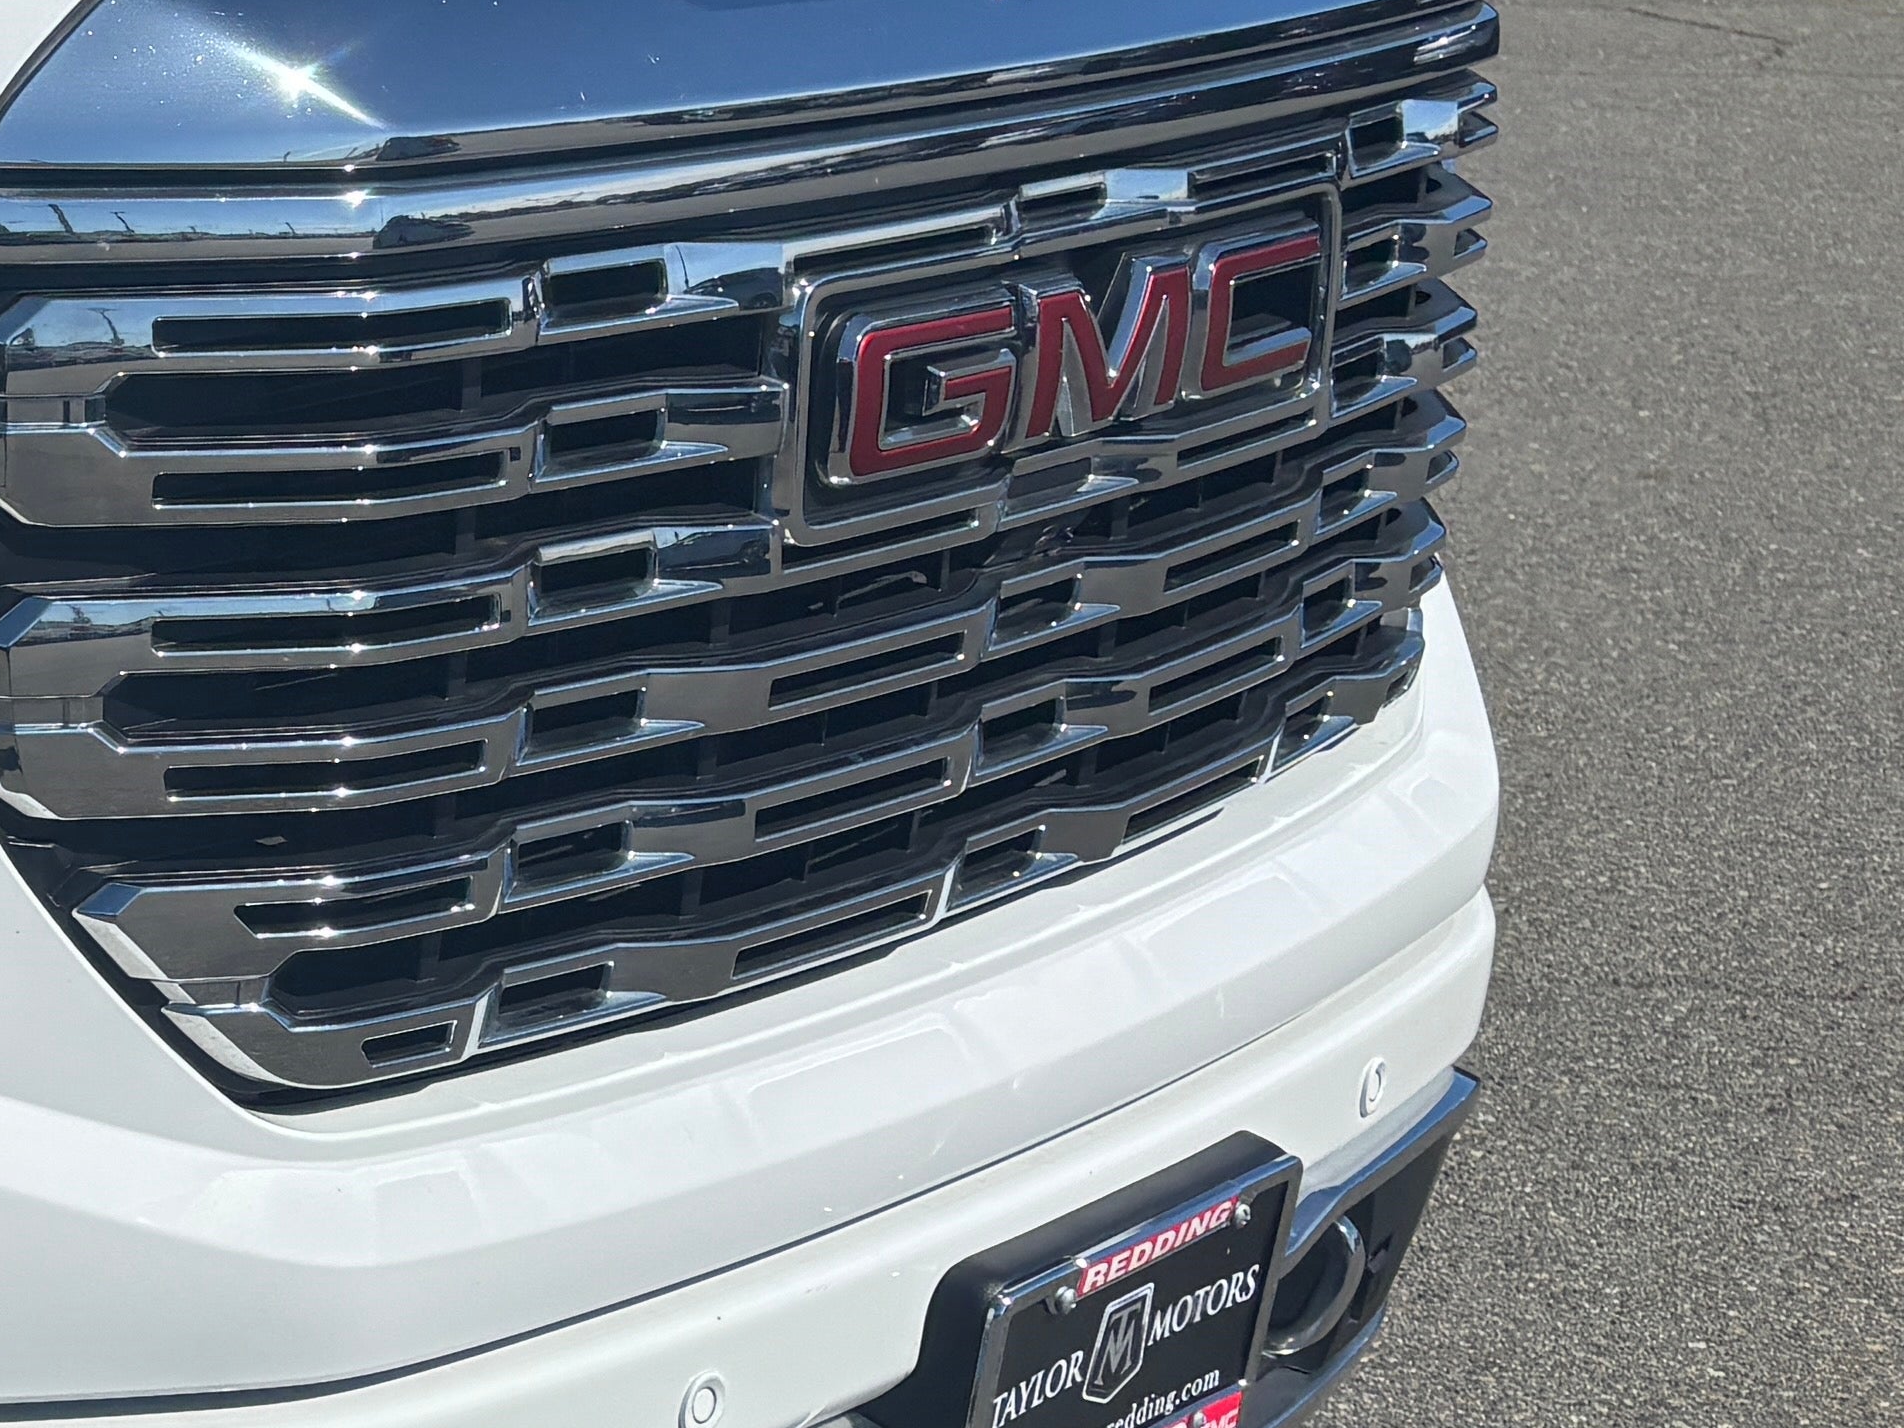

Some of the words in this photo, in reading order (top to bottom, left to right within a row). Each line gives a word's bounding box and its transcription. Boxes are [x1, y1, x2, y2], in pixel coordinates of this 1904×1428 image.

[837, 227, 1322, 480] GMC
[1081, 1199, 1236, 1294] REDDING
[1147, 1263, 1261, 1347] MOTORS
